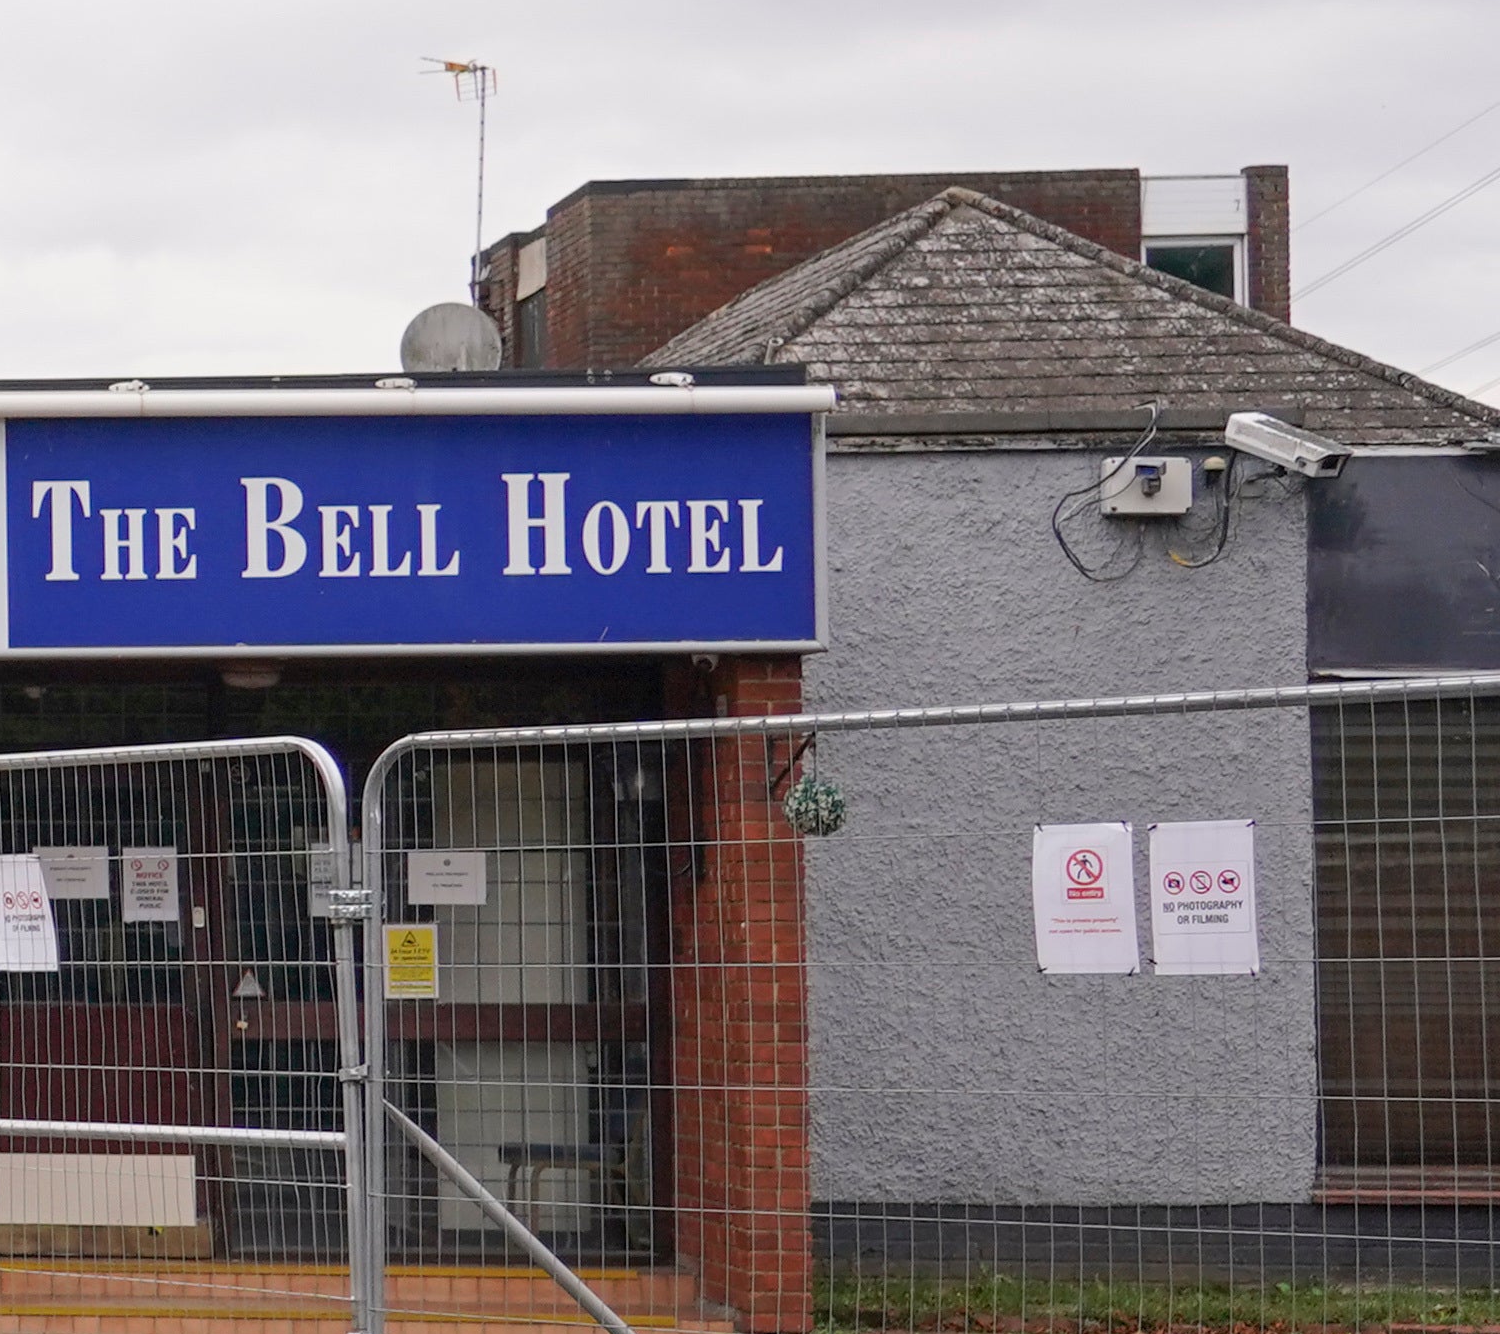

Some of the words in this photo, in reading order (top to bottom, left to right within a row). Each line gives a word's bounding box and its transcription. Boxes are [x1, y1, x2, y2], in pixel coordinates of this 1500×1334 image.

[1162, 902, 1175, 913] NO
[1177, 899, 1244, 911] PHOTOGRAPHY
[1177, 914, 1190, 925] OR
[1191, 913, 1229, 925] FILMING
